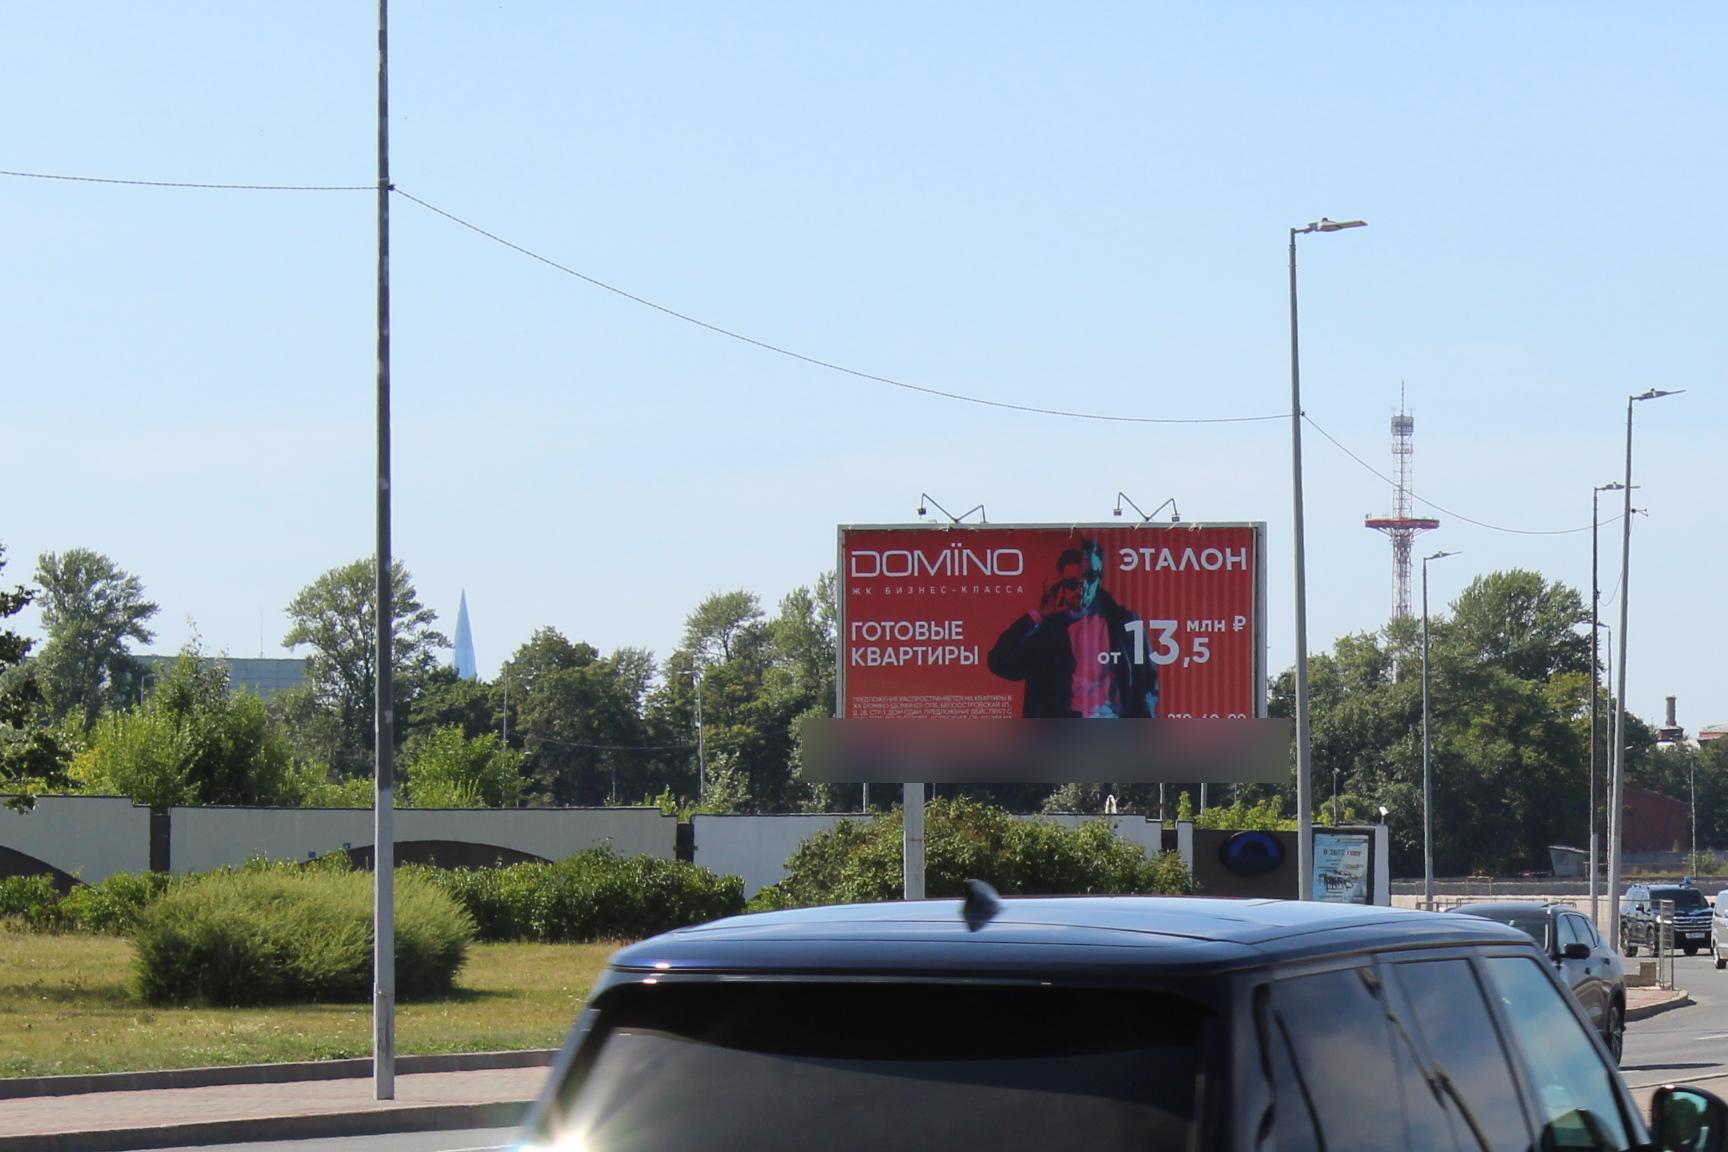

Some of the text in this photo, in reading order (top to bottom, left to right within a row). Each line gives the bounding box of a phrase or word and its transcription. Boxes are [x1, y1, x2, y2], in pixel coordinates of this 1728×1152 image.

[1119, 547, 1248, 572] ЭТАЛОН
[851, 585, 1024, 596] ЖК БИЗНЕС-КЛАССА
[851, 620, 964, 642] ГОТОВЫЕ
[851, 645, 979, 667] КВАРТИРЫ
